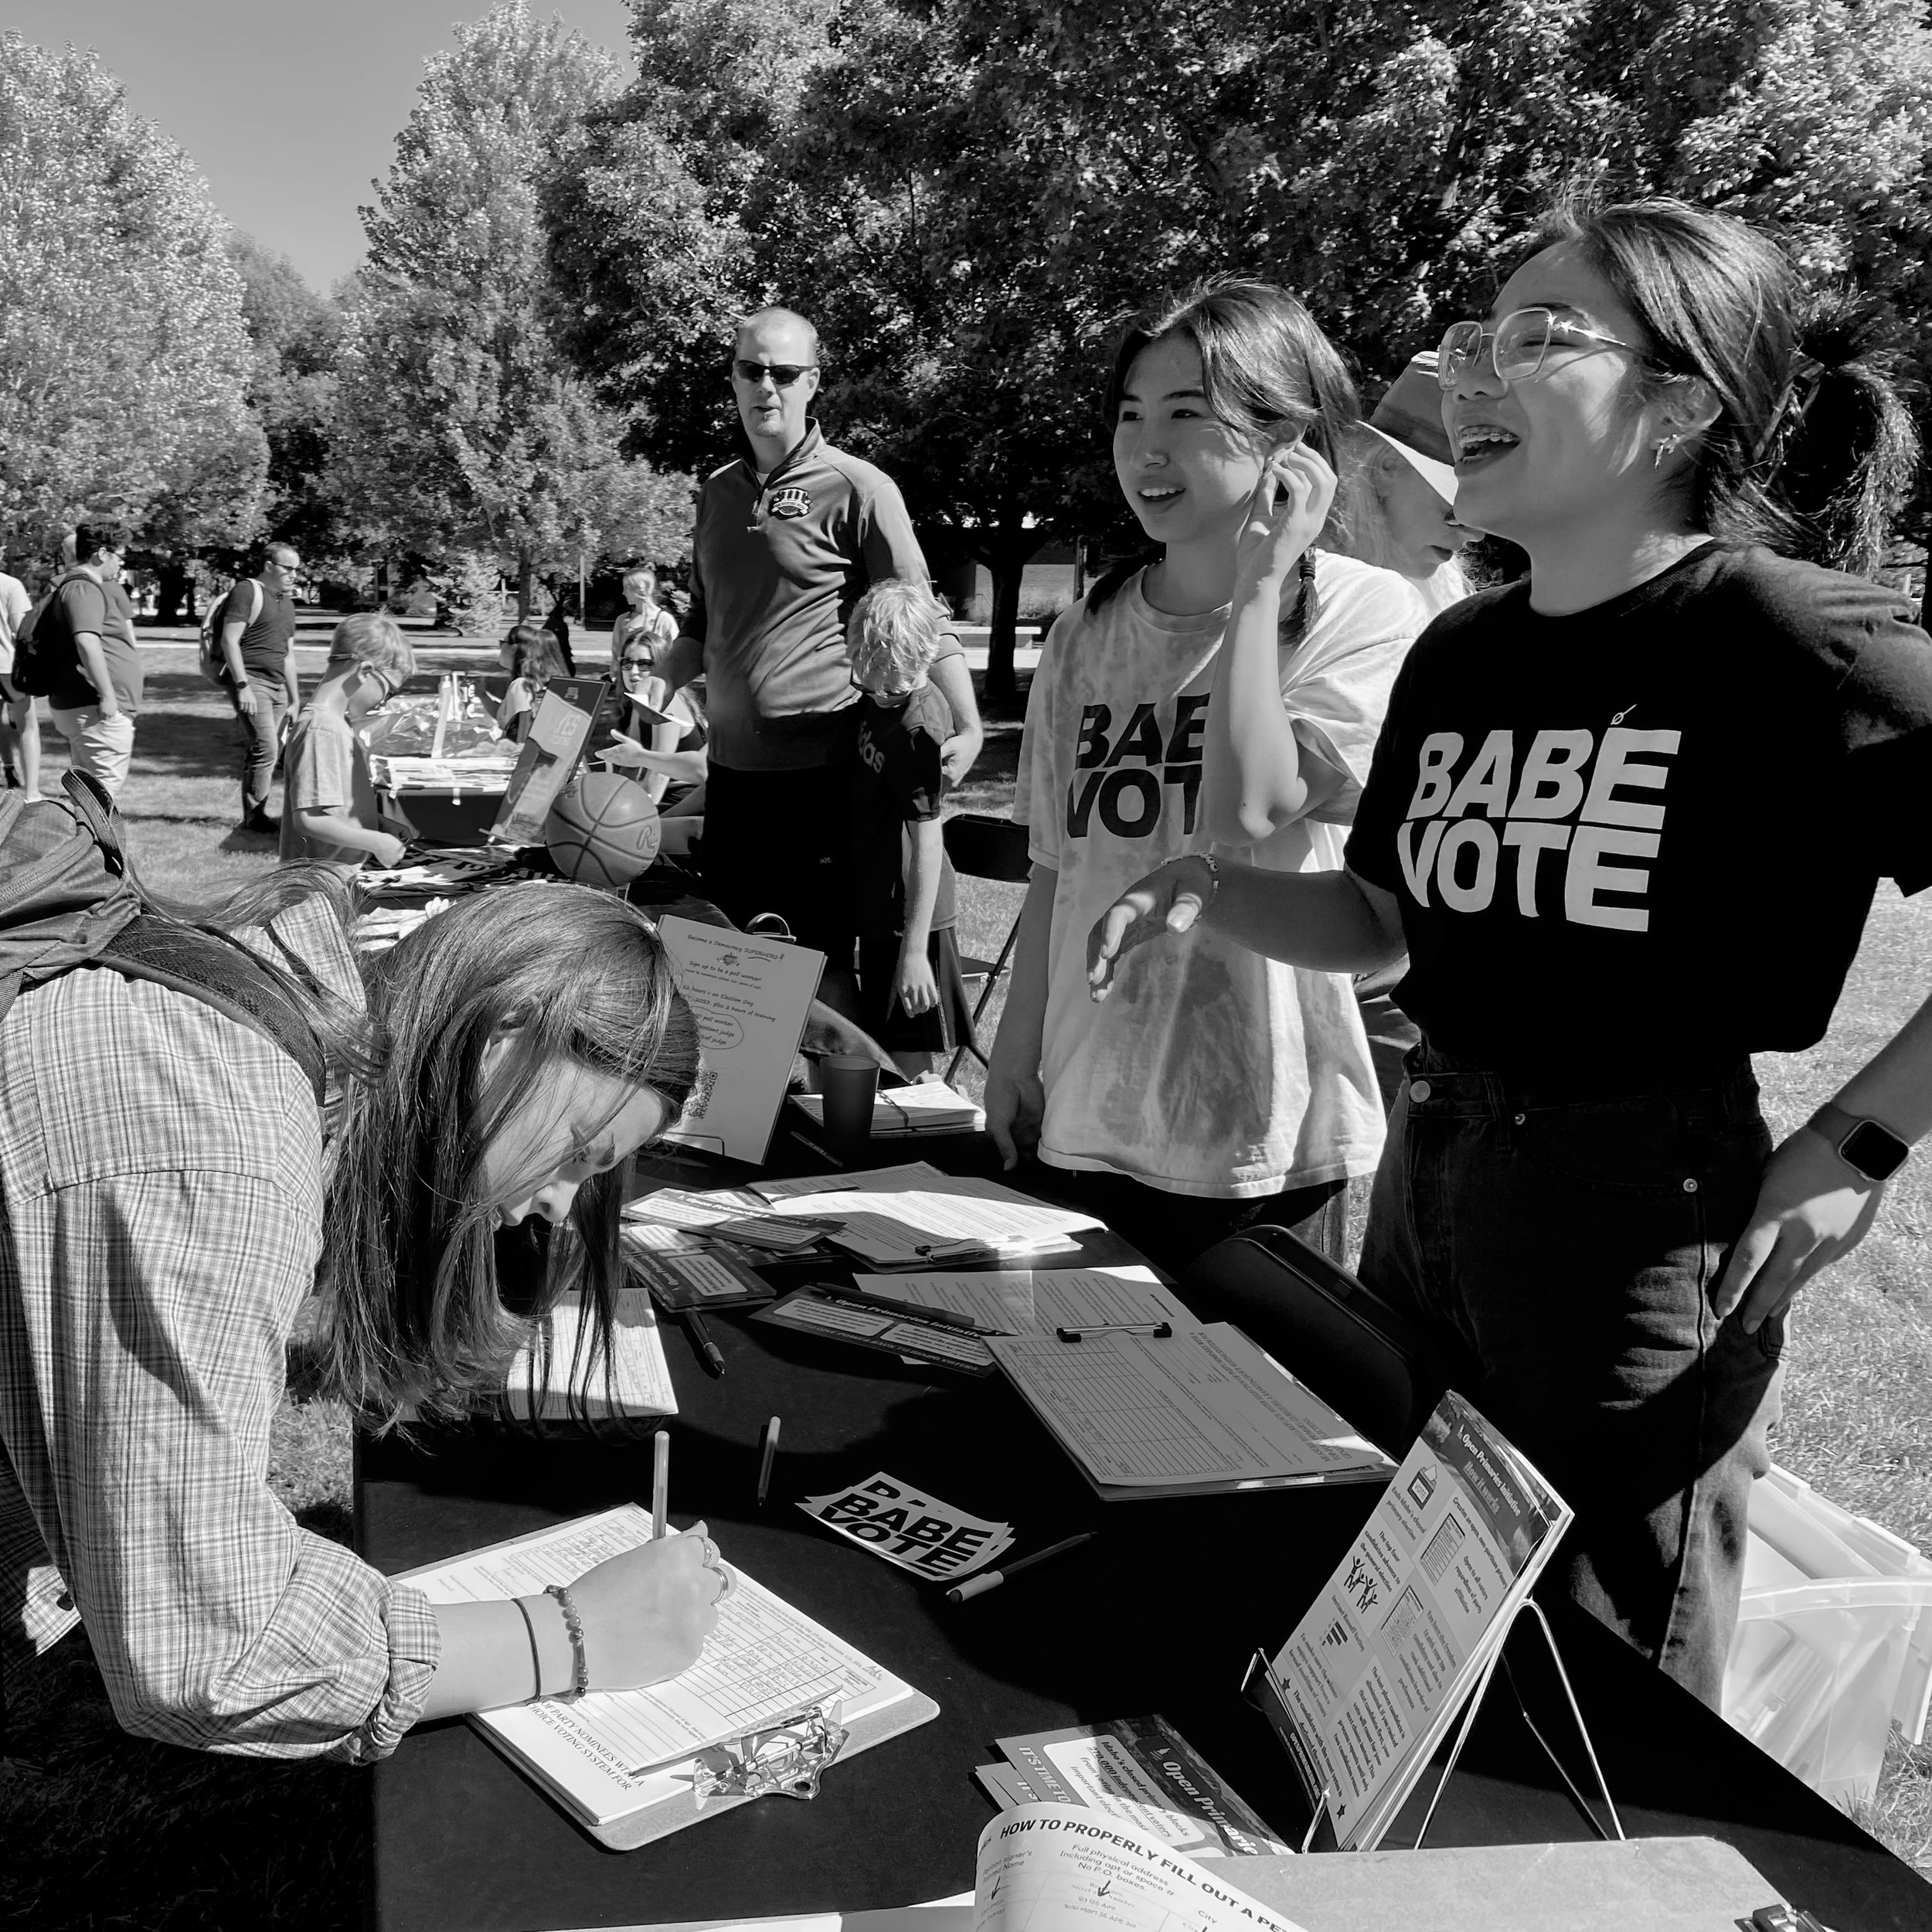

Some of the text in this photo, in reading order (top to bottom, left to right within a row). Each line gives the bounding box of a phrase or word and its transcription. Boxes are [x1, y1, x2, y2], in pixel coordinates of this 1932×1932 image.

[1067, 764, 1202, 838] VOT
[1406, 727, 1682, 829] BABE
[1397, 819, 1661, 931] VOTE
[744, 947, 777, 959] SUPERHERO
[928, 1320, 983, 1338] Initiativ
[1414, 1481, 1427, 1499] VOTE
[1462, 1434, 1520, 1515] Open Primaries Initiative
[1464, 1461, 1499, 1512] How it works
[818, 1505, 971, 1573] VOTE
[829, 1493, 994, 1557] BABE
[552, 1708, 577, 1730] PARTY
[574, 1727, 617, 1762] NOMINEES
[634, 1779, 645, 1787] A
[553, 1724, 584, 1750] VOTING
[582, 1748, 615, 1777] SYSTEM
[612, 1774, 633, 1791] FOR
[1019, 1747, 1072, 1802] IT'S TIME TO
[1070, 1766, 1120, 1817] important elect
[1080, 1757, 1102, 1773] from
[1095, 1774, 1115, 1794] voting
[1119, 1803, 1131, 1813] the
[1100, 1741, 1189, 1835] Idaho's closed primary blocks
[1111, 1775, 1152, 1815] independent
[1149, 1816, 1172, 1837] voters
[1163, 1761, 1257, 1853] Open Primarie
[1000, 1818, 1289, 1932] HOW TO PROPERLY FILL OUT A PE
[1060, 1850, 1103, 1866] Including
[1104, 1862, 1121, 1872] apt
[1135, 1875, 1164, 1891] space
[1072, 1844, 1169, 1886] Full physical address
[1077, 1862, 1146, 1891] No P.O. boxes.
[1198, 1910, 1218, 1924] City
